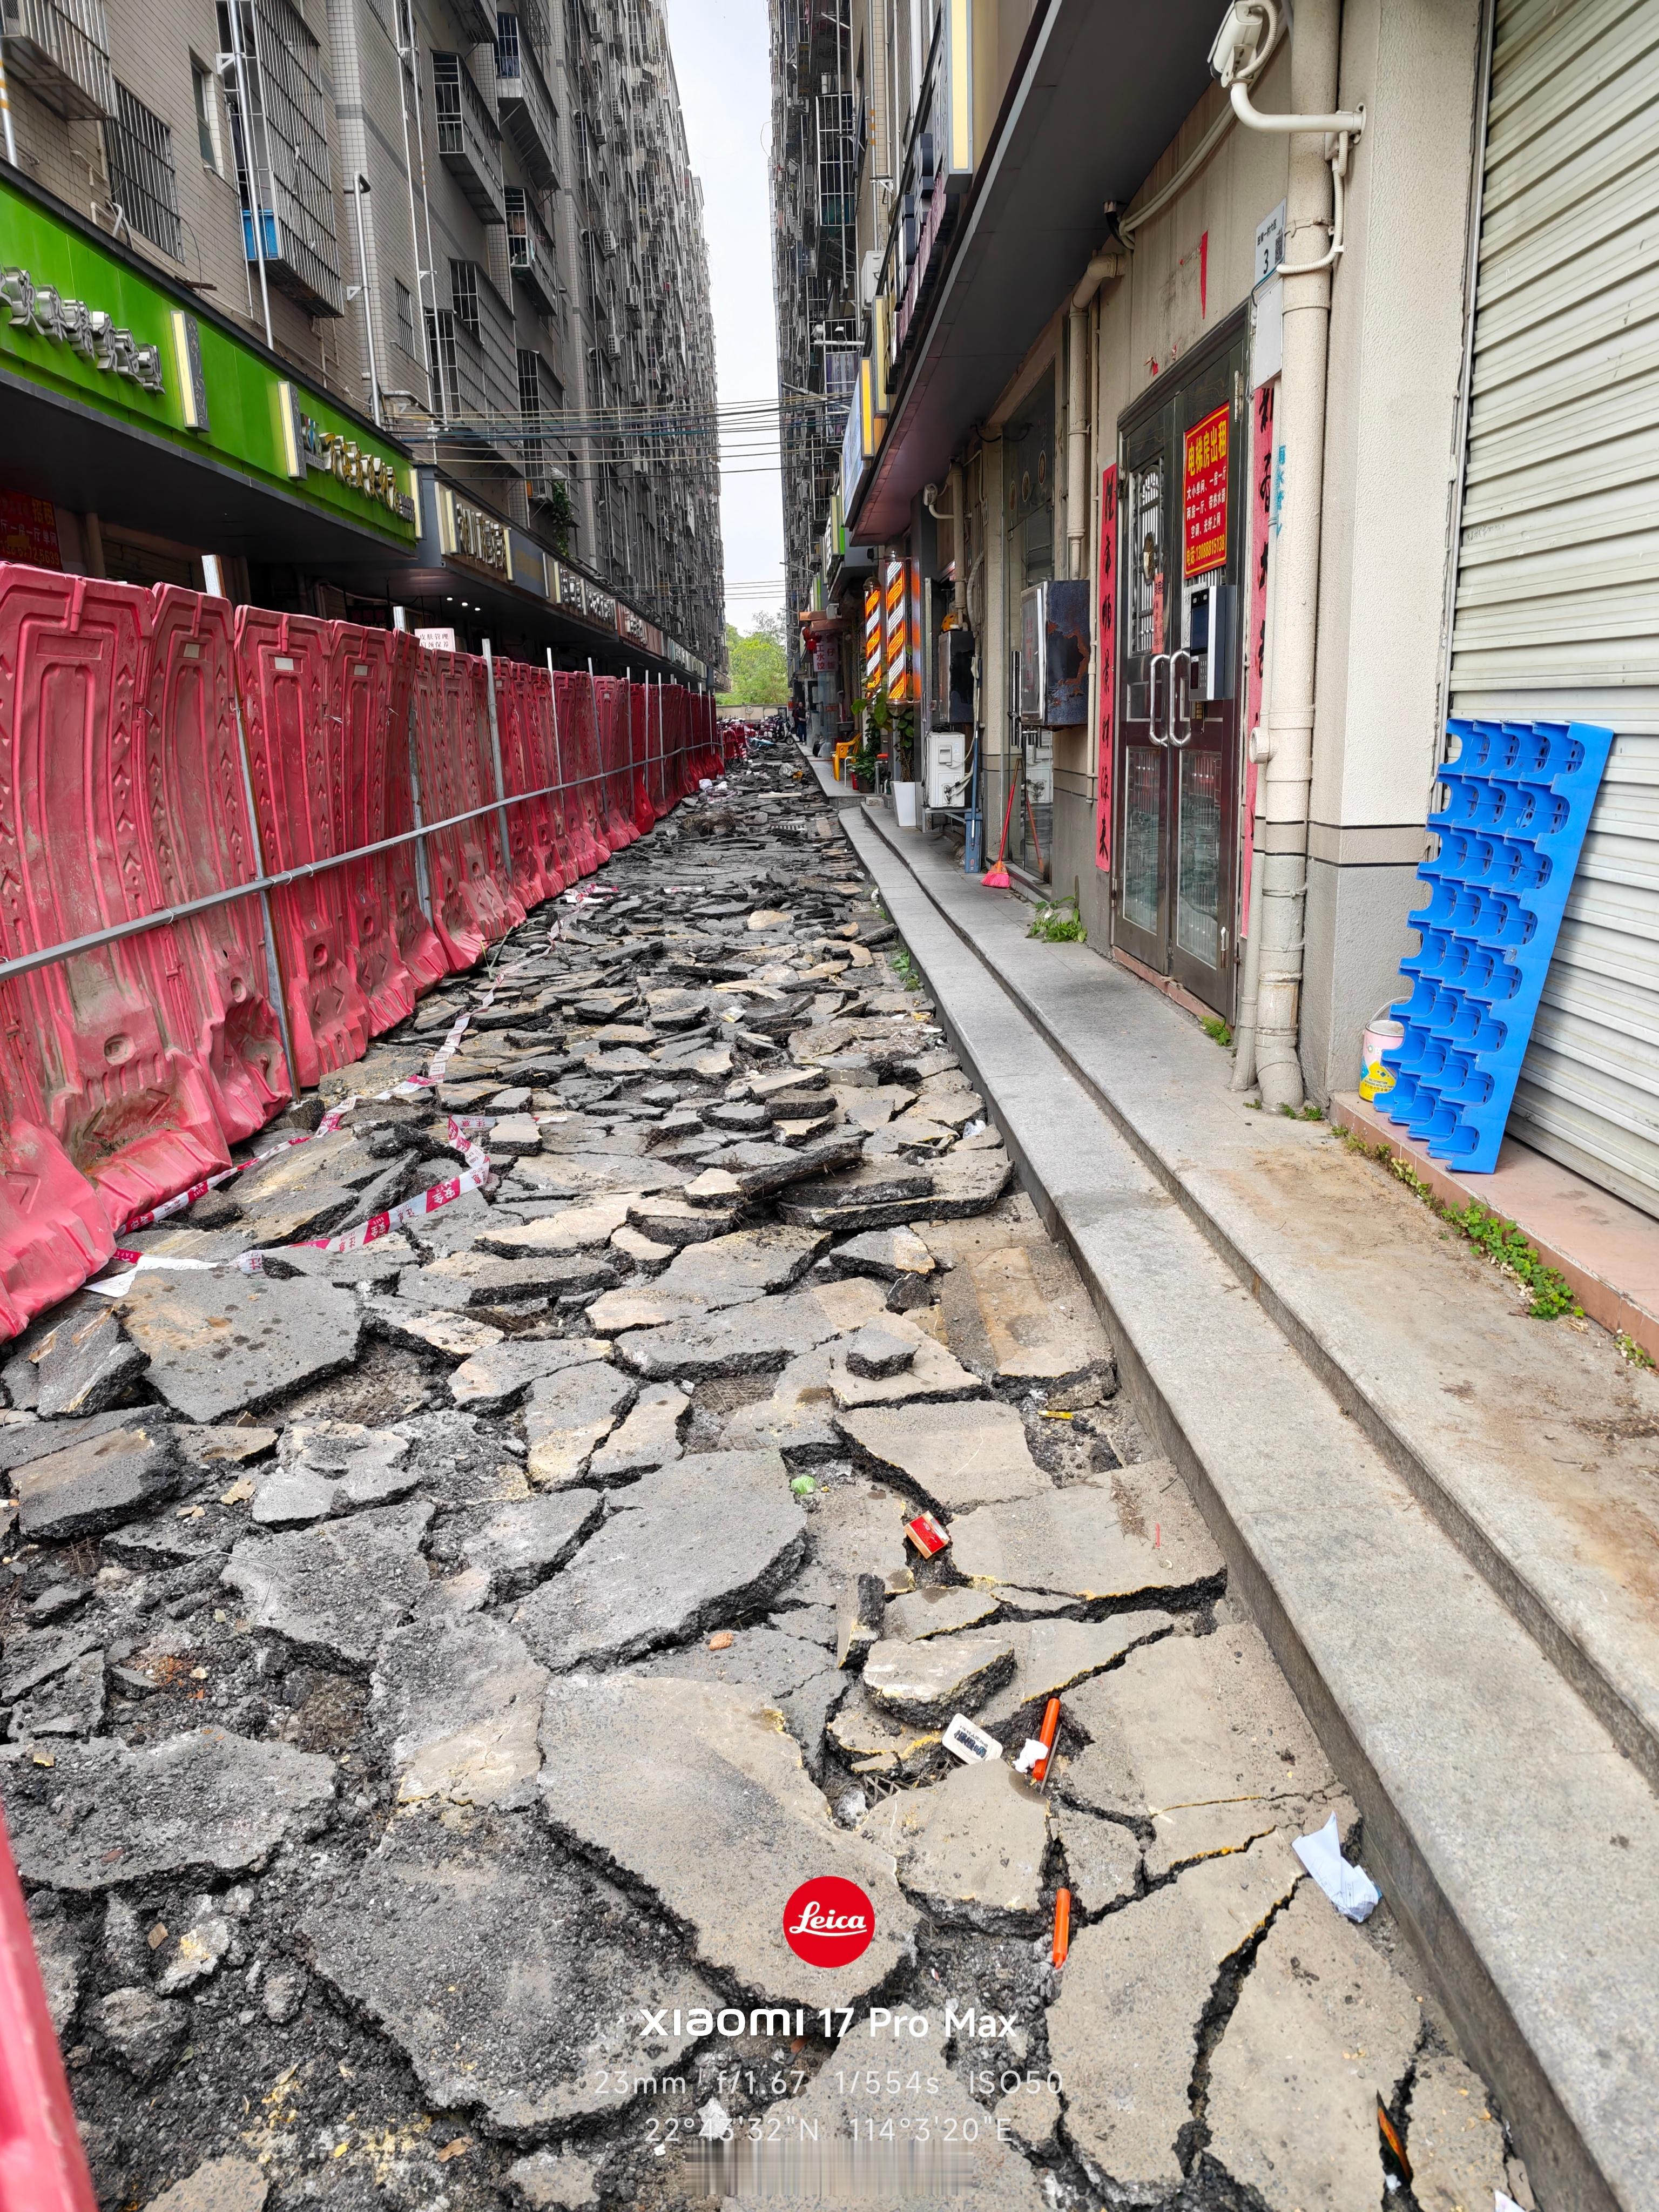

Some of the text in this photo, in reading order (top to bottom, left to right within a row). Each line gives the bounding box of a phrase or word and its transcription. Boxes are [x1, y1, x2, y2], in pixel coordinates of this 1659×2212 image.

[1263, 248, 1269, 274] 3
[1188, 420, 1227, 476] 电梯房出租
[1191, 511, 1221, 539] 空调、光纤上网
[816, 639, 825, 670] 工水饺
[431, 1186, 456, 1204] 安全
[371, 1222, 386, 1238] 安全
[116, 1251, 134, 1259] SAFE
